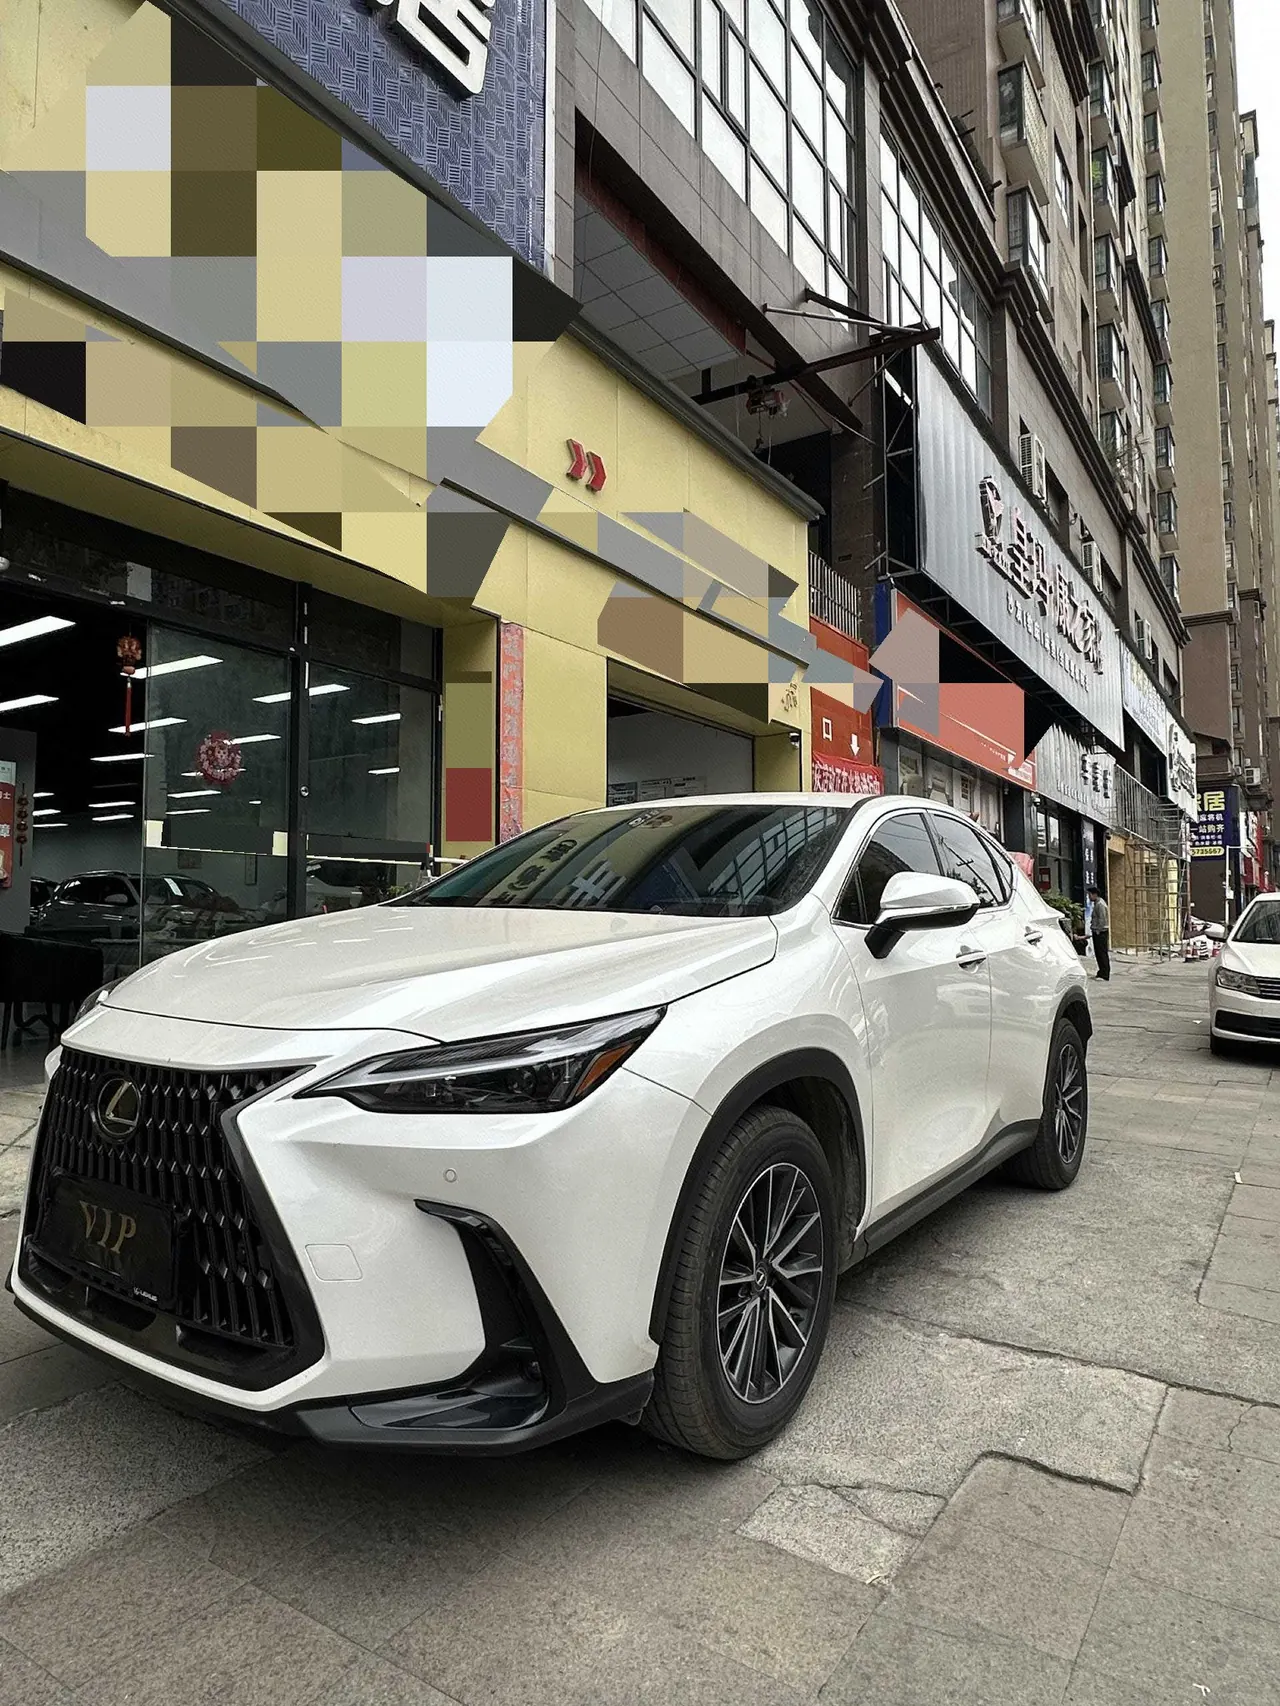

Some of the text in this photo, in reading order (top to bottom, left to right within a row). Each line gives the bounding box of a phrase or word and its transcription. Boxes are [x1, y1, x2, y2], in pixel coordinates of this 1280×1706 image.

[1190, 824, 1225, 833] 一站购齐
[79, 1200, 137, 1254] VIP
